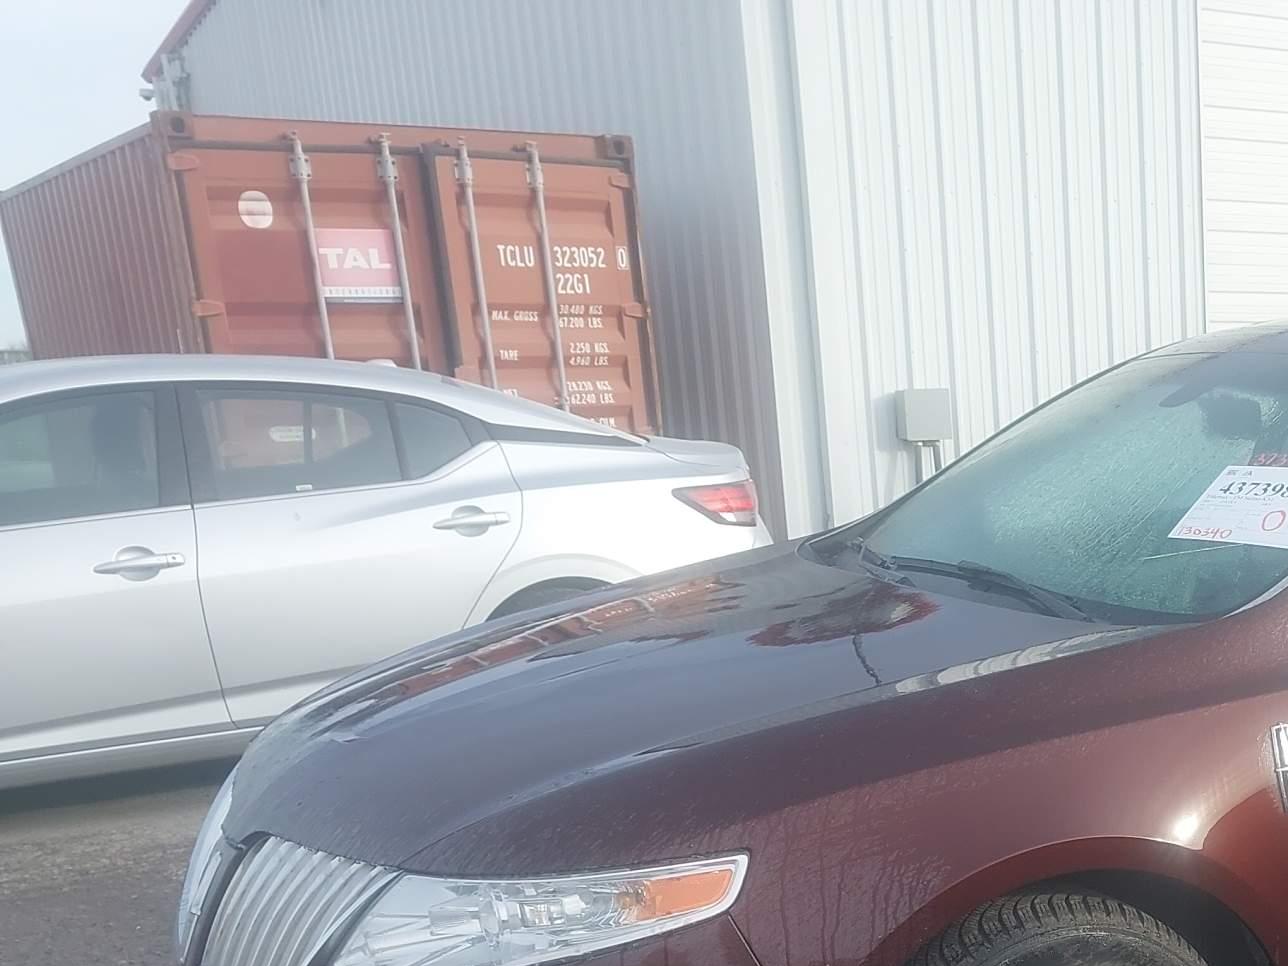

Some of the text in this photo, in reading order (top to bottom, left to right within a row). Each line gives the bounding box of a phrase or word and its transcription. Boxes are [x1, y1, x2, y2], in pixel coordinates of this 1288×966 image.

[318, 247, 391, 269] TAL
[496, 244, 535, 267] TCLU
[552, 246, 607, 268] 323052
[555, 272, 591, 294] 22G1
[513, 311, 538, 322] GROSS
[500, 350, 518, 361] TARE
